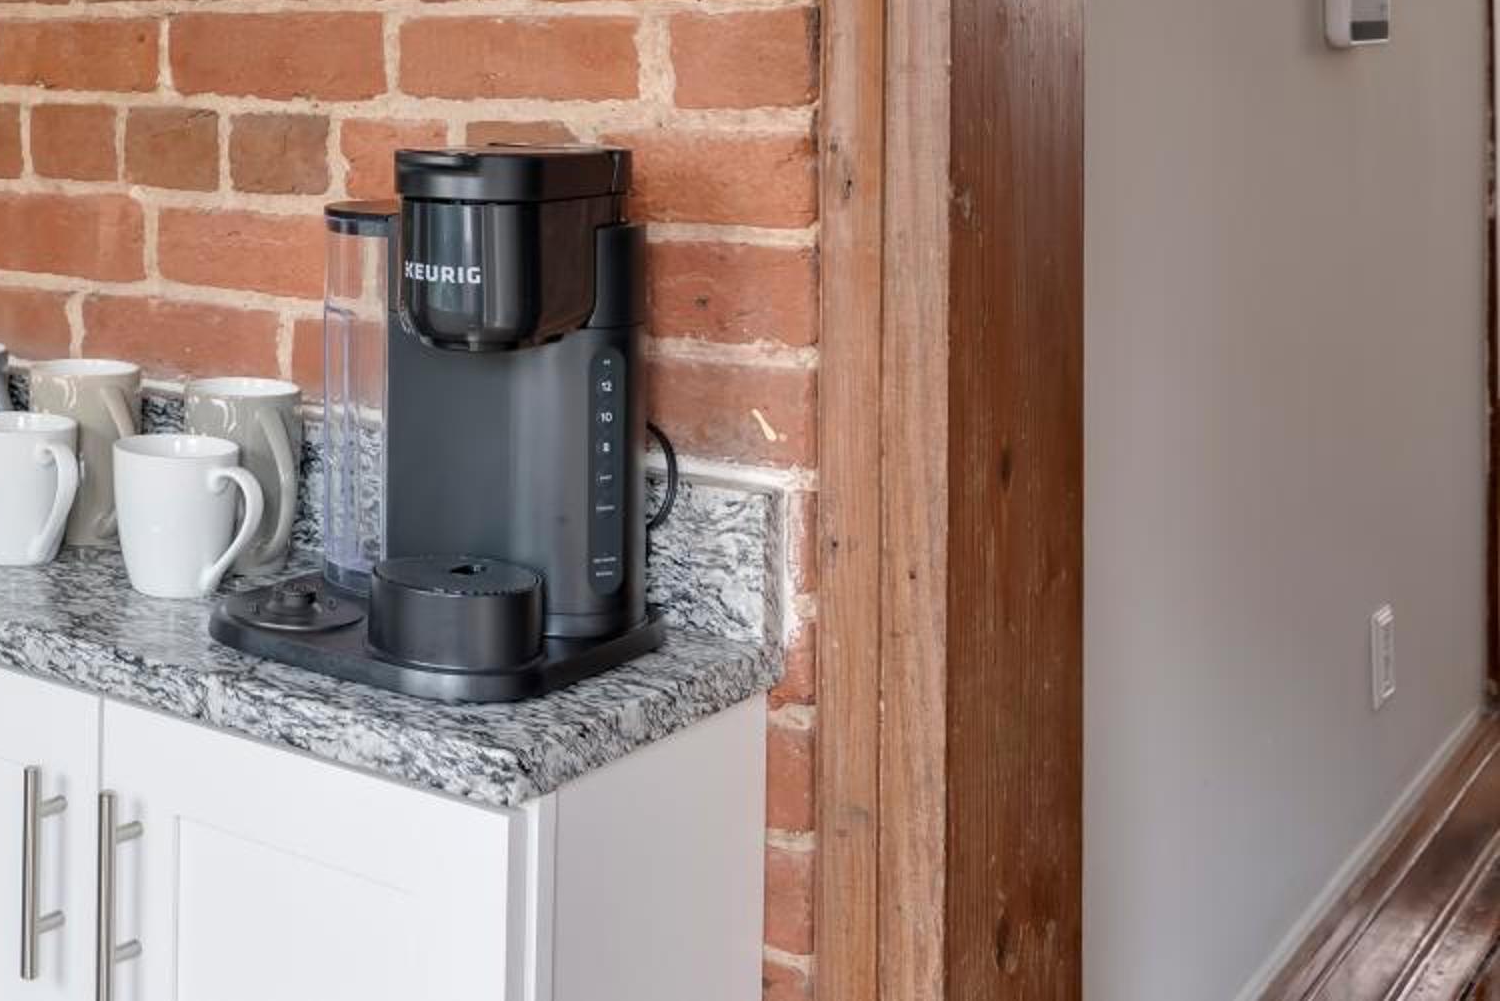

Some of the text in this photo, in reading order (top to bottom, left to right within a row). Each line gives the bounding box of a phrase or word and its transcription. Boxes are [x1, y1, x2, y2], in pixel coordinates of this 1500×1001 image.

[404, 260, 481, 284] KEURIG
[601, 380, 612, 392] 12
[600, 411, 613, 423] 10
